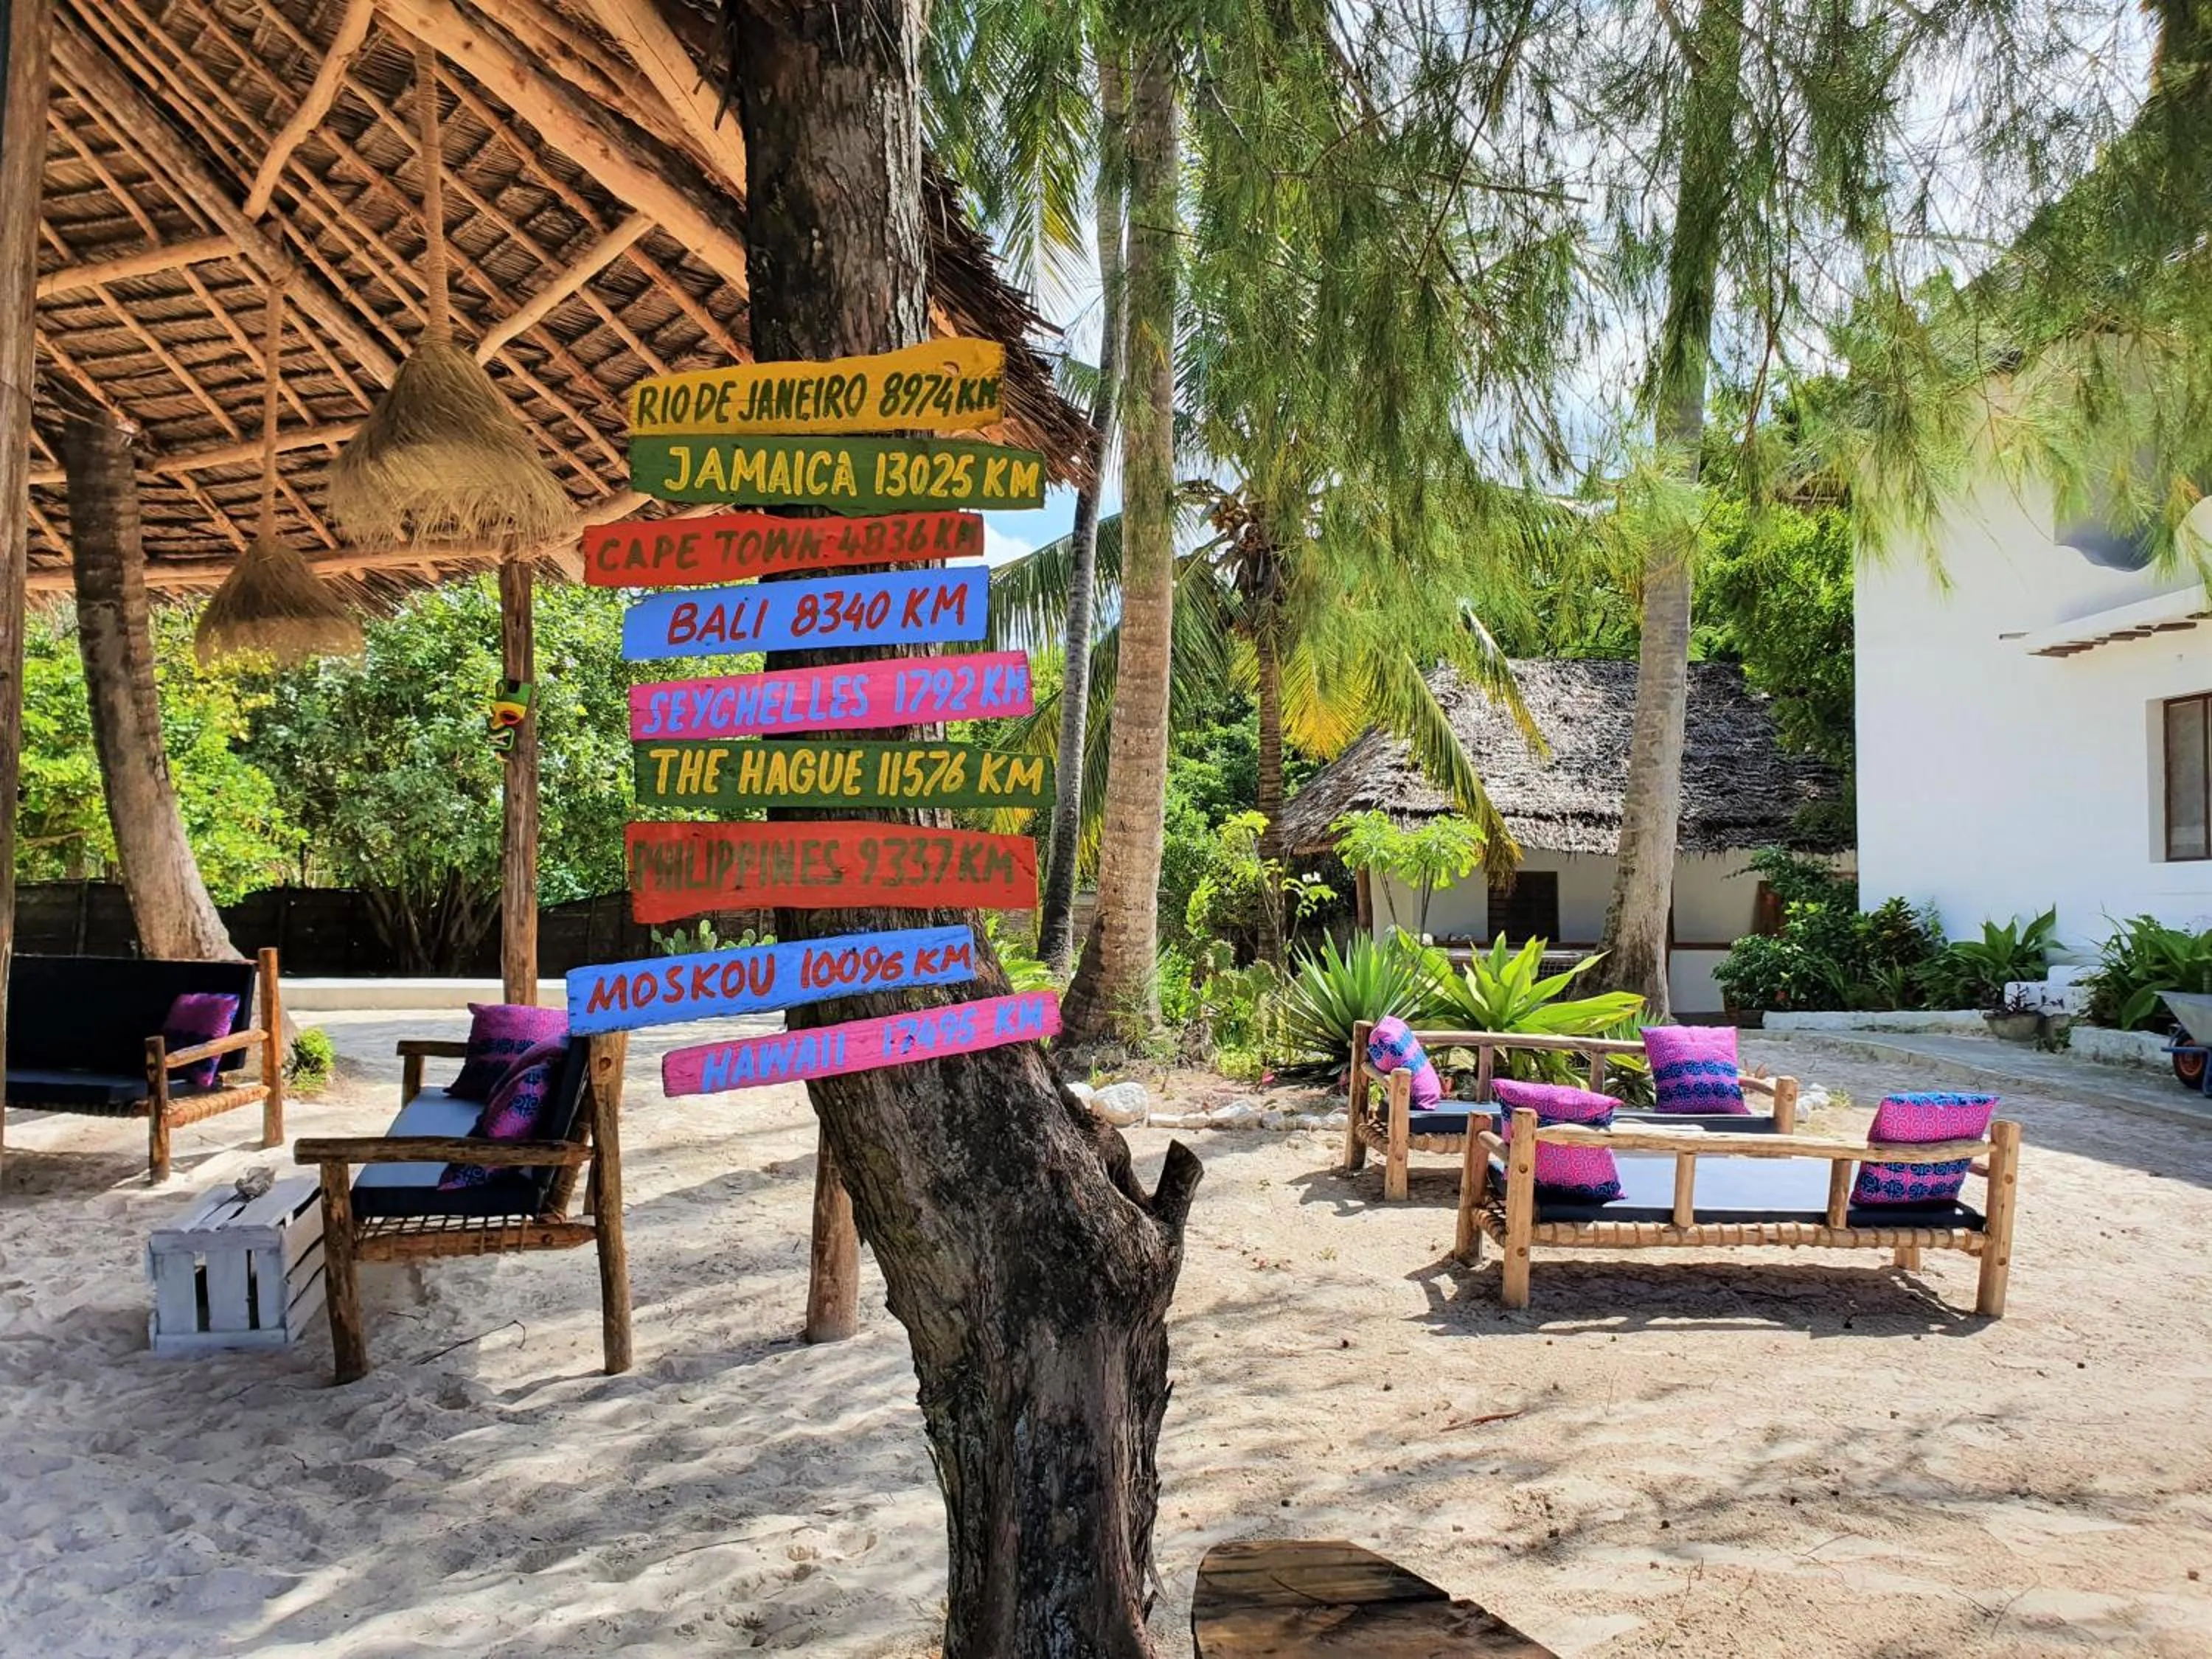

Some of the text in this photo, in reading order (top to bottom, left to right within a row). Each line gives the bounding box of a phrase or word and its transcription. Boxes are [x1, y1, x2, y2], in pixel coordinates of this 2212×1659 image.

[738, 372, 869, 422] JANEIRO
[878, 371, 955, 418] 8974
[956, 377, 1001, 413] KM
[665, 446, 1040, 498] JAMAICA 13025 KM
[597, 517, 980, 571] CAPE TOWN 4836 KM
[667, 582, 968, 645] BALI 8340 KM
[641, 662, 1028, 734] SEYCHELLES 1792 KM
[648, 748, 1044, 796] THE HAGUE 11576 KM
[633, 838, 844, 892] PHILIPPINES
[958, 840, 1015, 886] KM
[586, 942, 974, 1015] MOSKOU 10096 KM
[701, 1032, 846, 1094] HAWAII
[994, 998, 1043, 1037] KM
